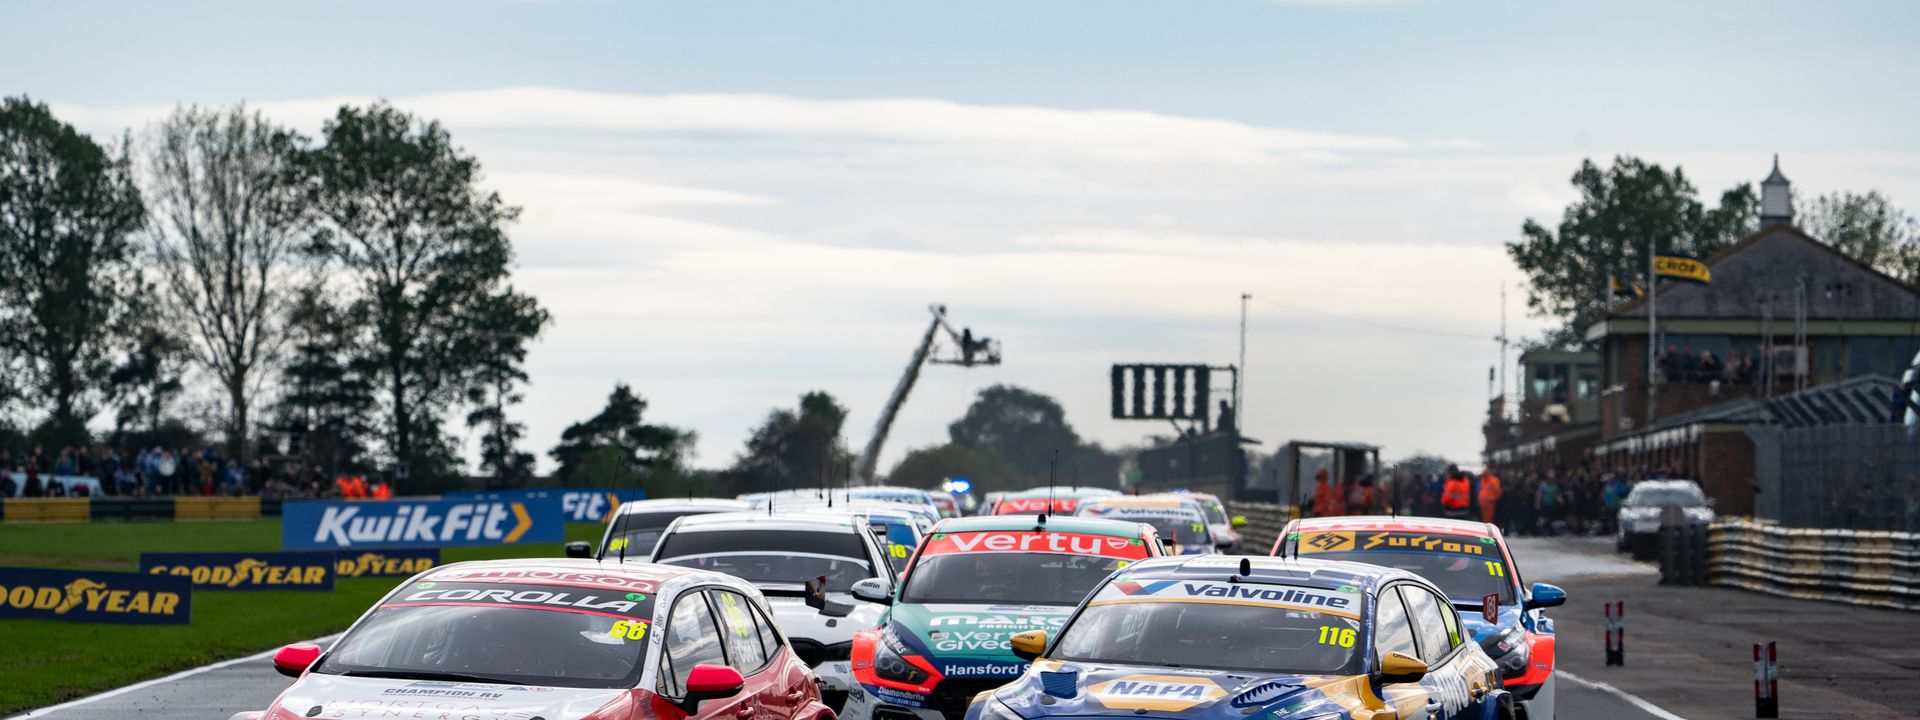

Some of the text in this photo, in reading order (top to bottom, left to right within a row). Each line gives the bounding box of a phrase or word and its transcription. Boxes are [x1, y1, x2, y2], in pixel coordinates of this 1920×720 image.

[1012, 498, 1075, 511] Vert
[949, 532, 1101, 555] Vertu
[1484, 561, 1504, 577] 11
[404, 589, 638, 613] COROLLA
[1184, 583, 1350, 609] Valvoline
[611, 620, 648, 640] 66
[1318, 625, 1357, 648] 116
[945, 663, 1018, 676] Hansford
[384, 687, 473, 699] CHAMPION
[1108, 680, 1207, 700] NAPA
